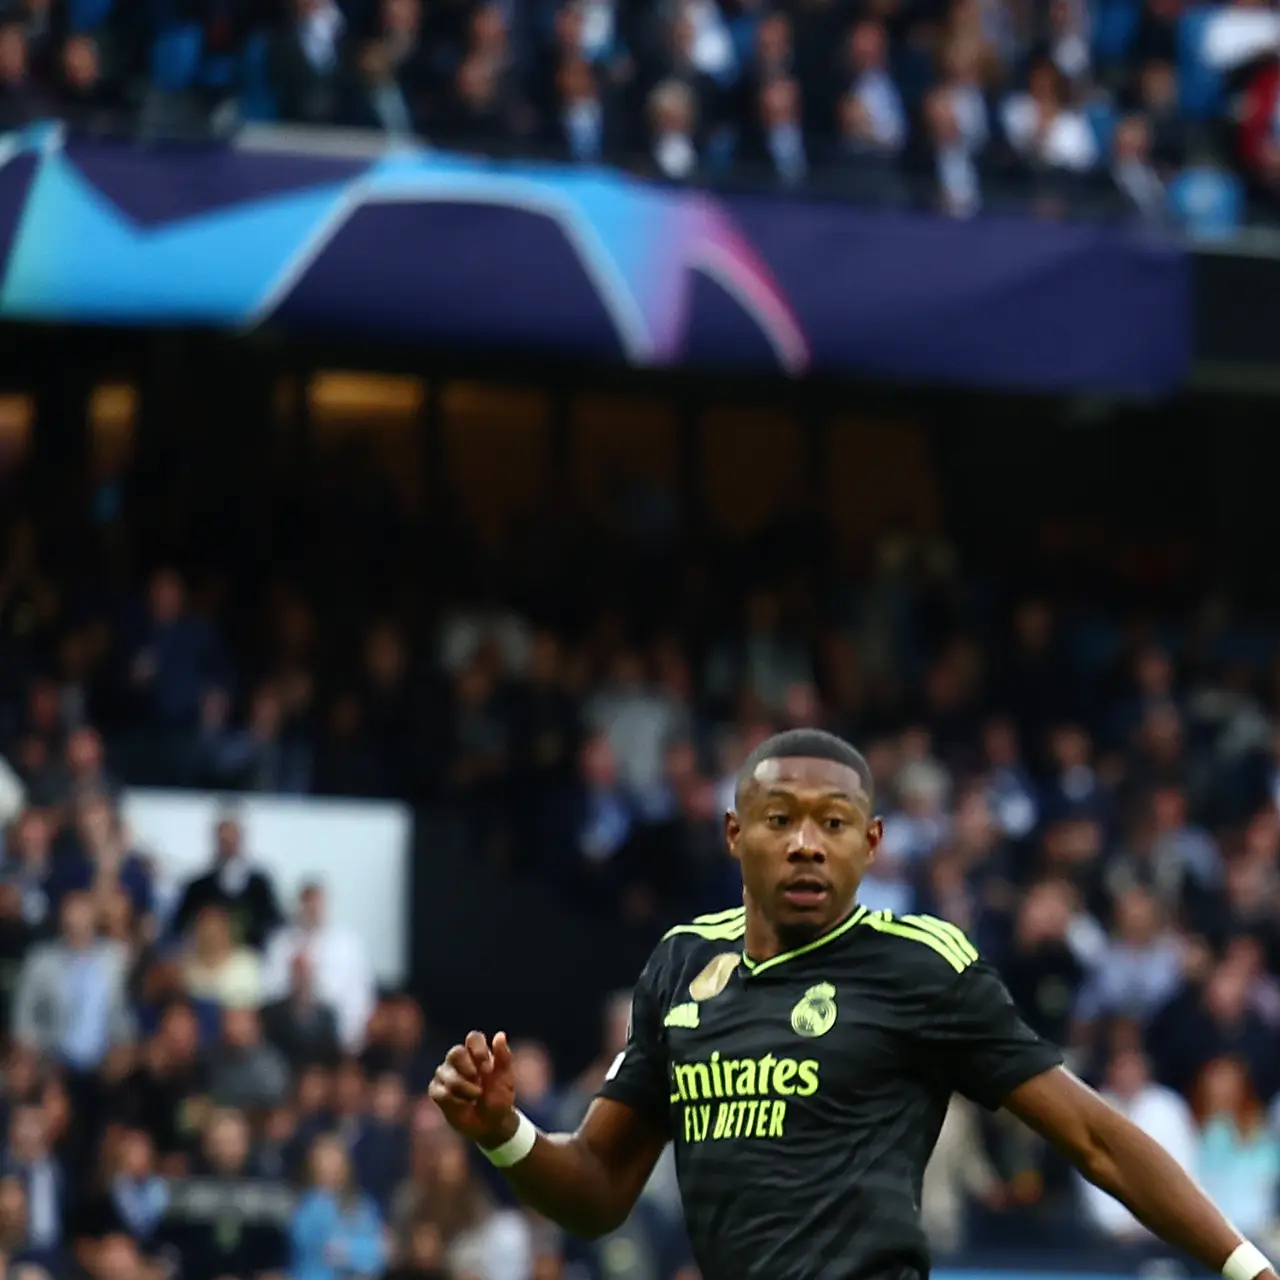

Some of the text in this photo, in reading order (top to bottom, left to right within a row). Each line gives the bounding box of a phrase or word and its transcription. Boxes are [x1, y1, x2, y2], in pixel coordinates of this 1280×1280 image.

[670, 1051, 820, 1103] mirates
[684, 1100, 787, 1143] FLY BETTER
